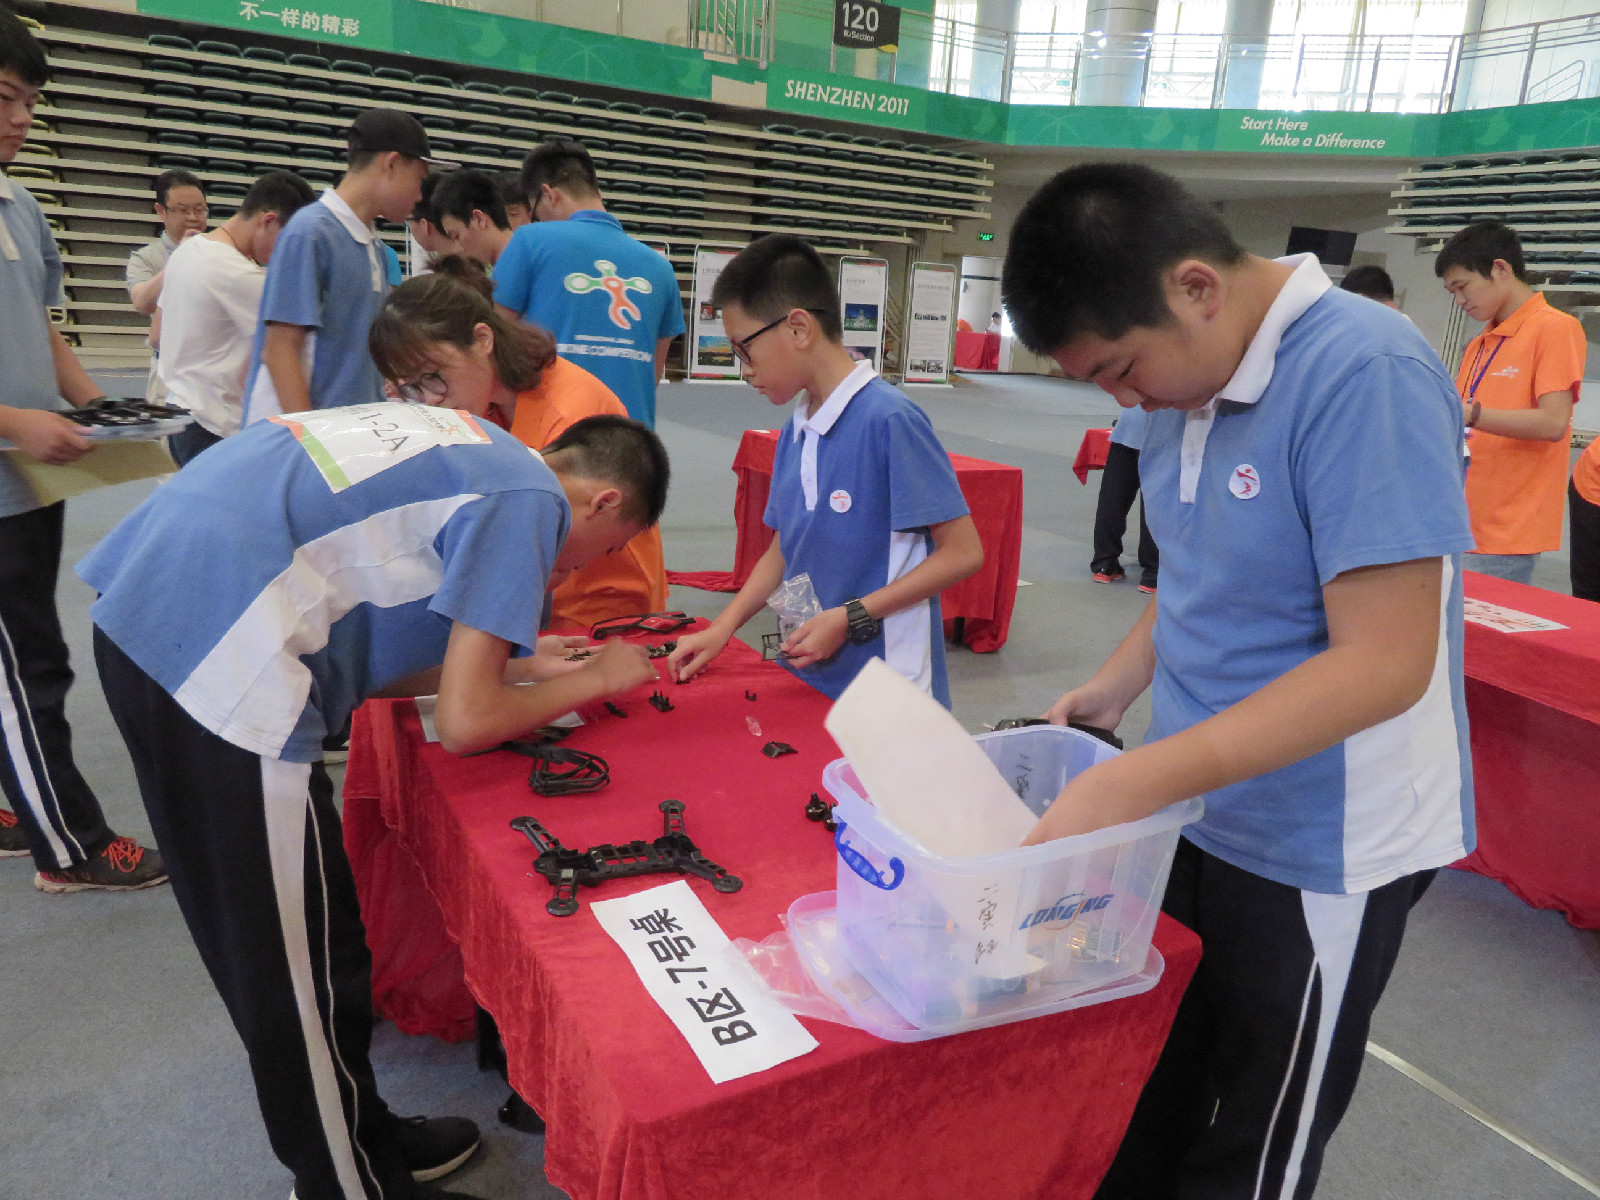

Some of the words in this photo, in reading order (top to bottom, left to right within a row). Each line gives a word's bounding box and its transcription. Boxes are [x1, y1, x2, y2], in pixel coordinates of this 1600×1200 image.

[239, 1, 360, 37] 不一样的精彩
[842, 1, 879, 33] 120
[784, 79, 876, 111] SHENZHEN
[877, 95, 910, 116] 2011
[1240, 116, 1274, 131] Start
[1275, 117, 1309, 131] Here
[1260, 132, 1300, 147] Make
[1302, 136, 1313, 147] a
[1314, 133, 1386, 149] Difference
[629, 908, 758, 1046] B区-7号桌
